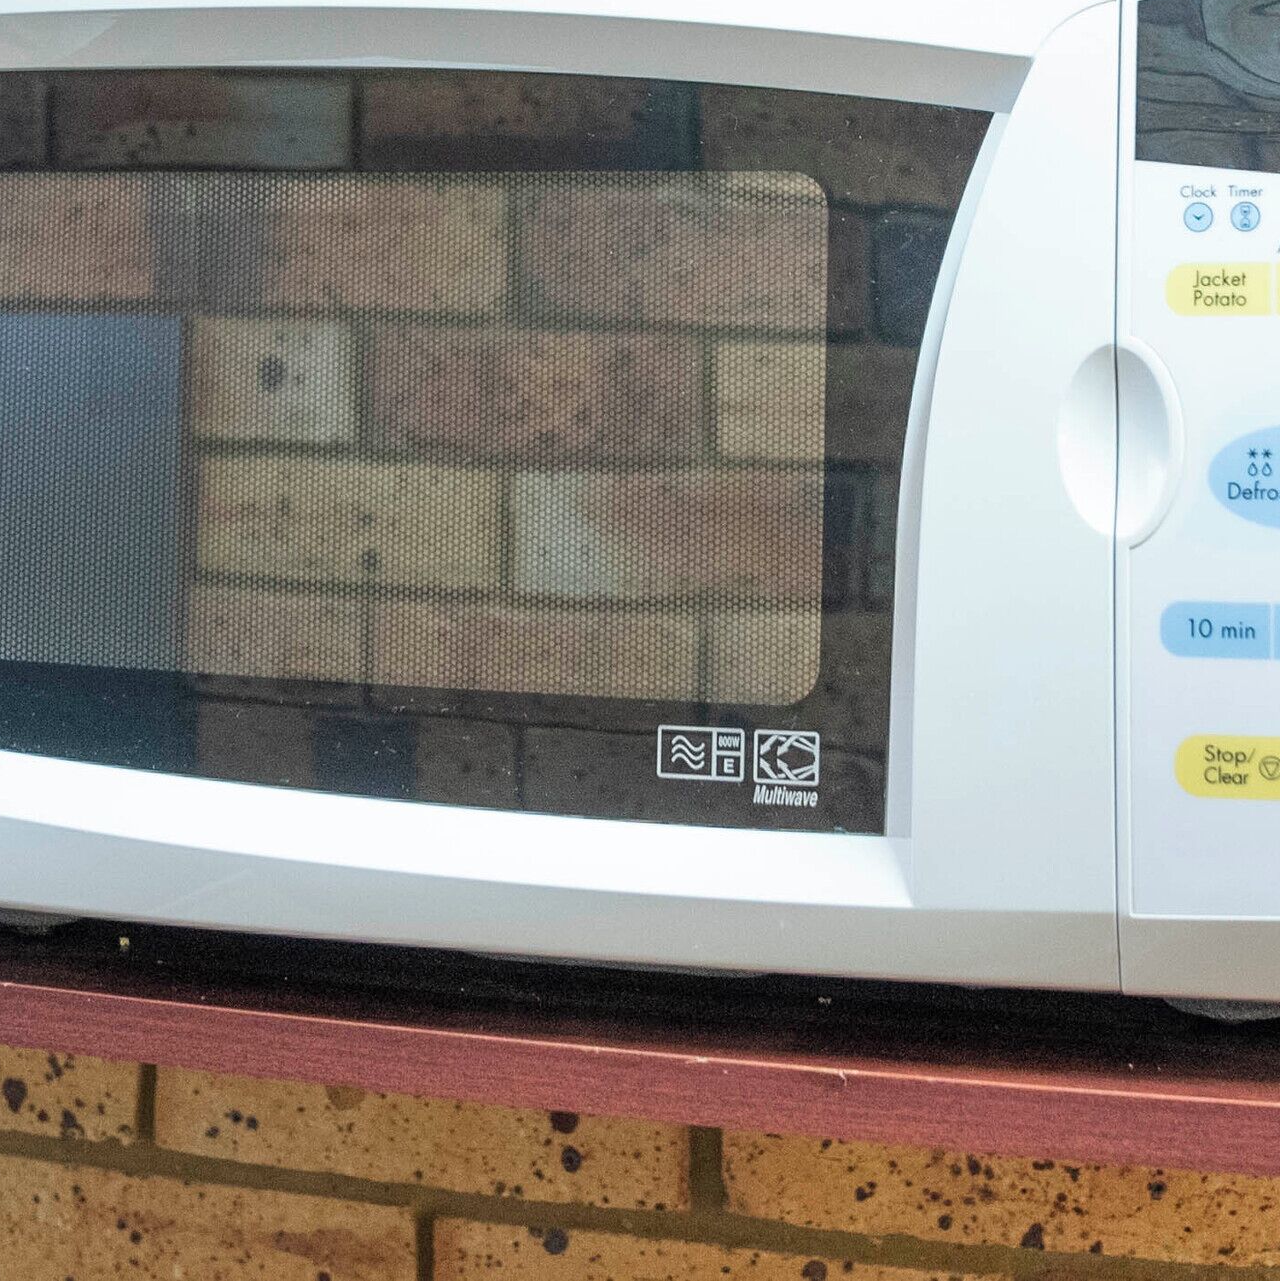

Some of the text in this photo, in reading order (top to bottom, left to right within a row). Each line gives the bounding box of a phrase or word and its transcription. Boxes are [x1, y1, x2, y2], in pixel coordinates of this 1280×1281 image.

[1179, 184, 1218, 199] Clock
[1227, 184, 1264, 199] Timer
[1192, 269, 1247, 288] Jacket
[1193, 289, 1247, 307] Potato
[1188, 619, 1256, 639] 10 min
[1204, 744, 1256, 767] Stop/
[723, 758, 735, 774] E
[1204, 765, 1249, 786] Clear
[752, 784, 819, 807] Multiwave
